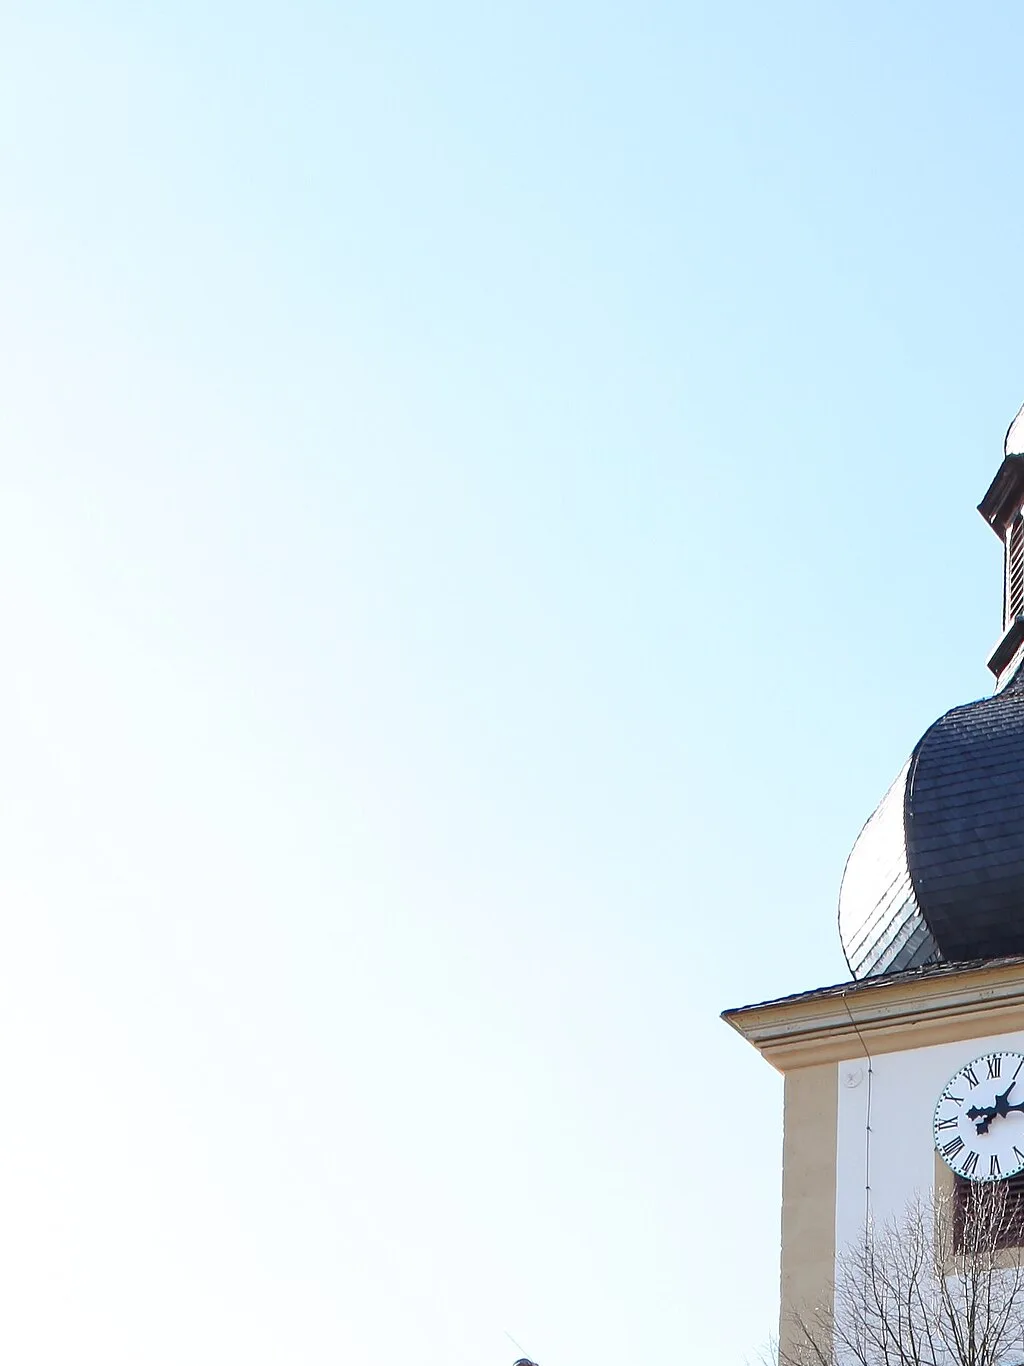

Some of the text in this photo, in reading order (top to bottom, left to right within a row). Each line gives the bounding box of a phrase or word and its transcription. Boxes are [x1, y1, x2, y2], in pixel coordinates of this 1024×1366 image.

[986, 1058, 1001, 1079] XII
[1012, 1061, 1024, 1080] I
[963, 1068, 980, 1090] XI
[945, 1091, 964, 1107] X
[938, 1116, 958, 1130] IX
[942, 1136, 965, 1160] VIII
[961, 1151, 980, 1175] VII
[990, 1155, 1002, 1175] VI
